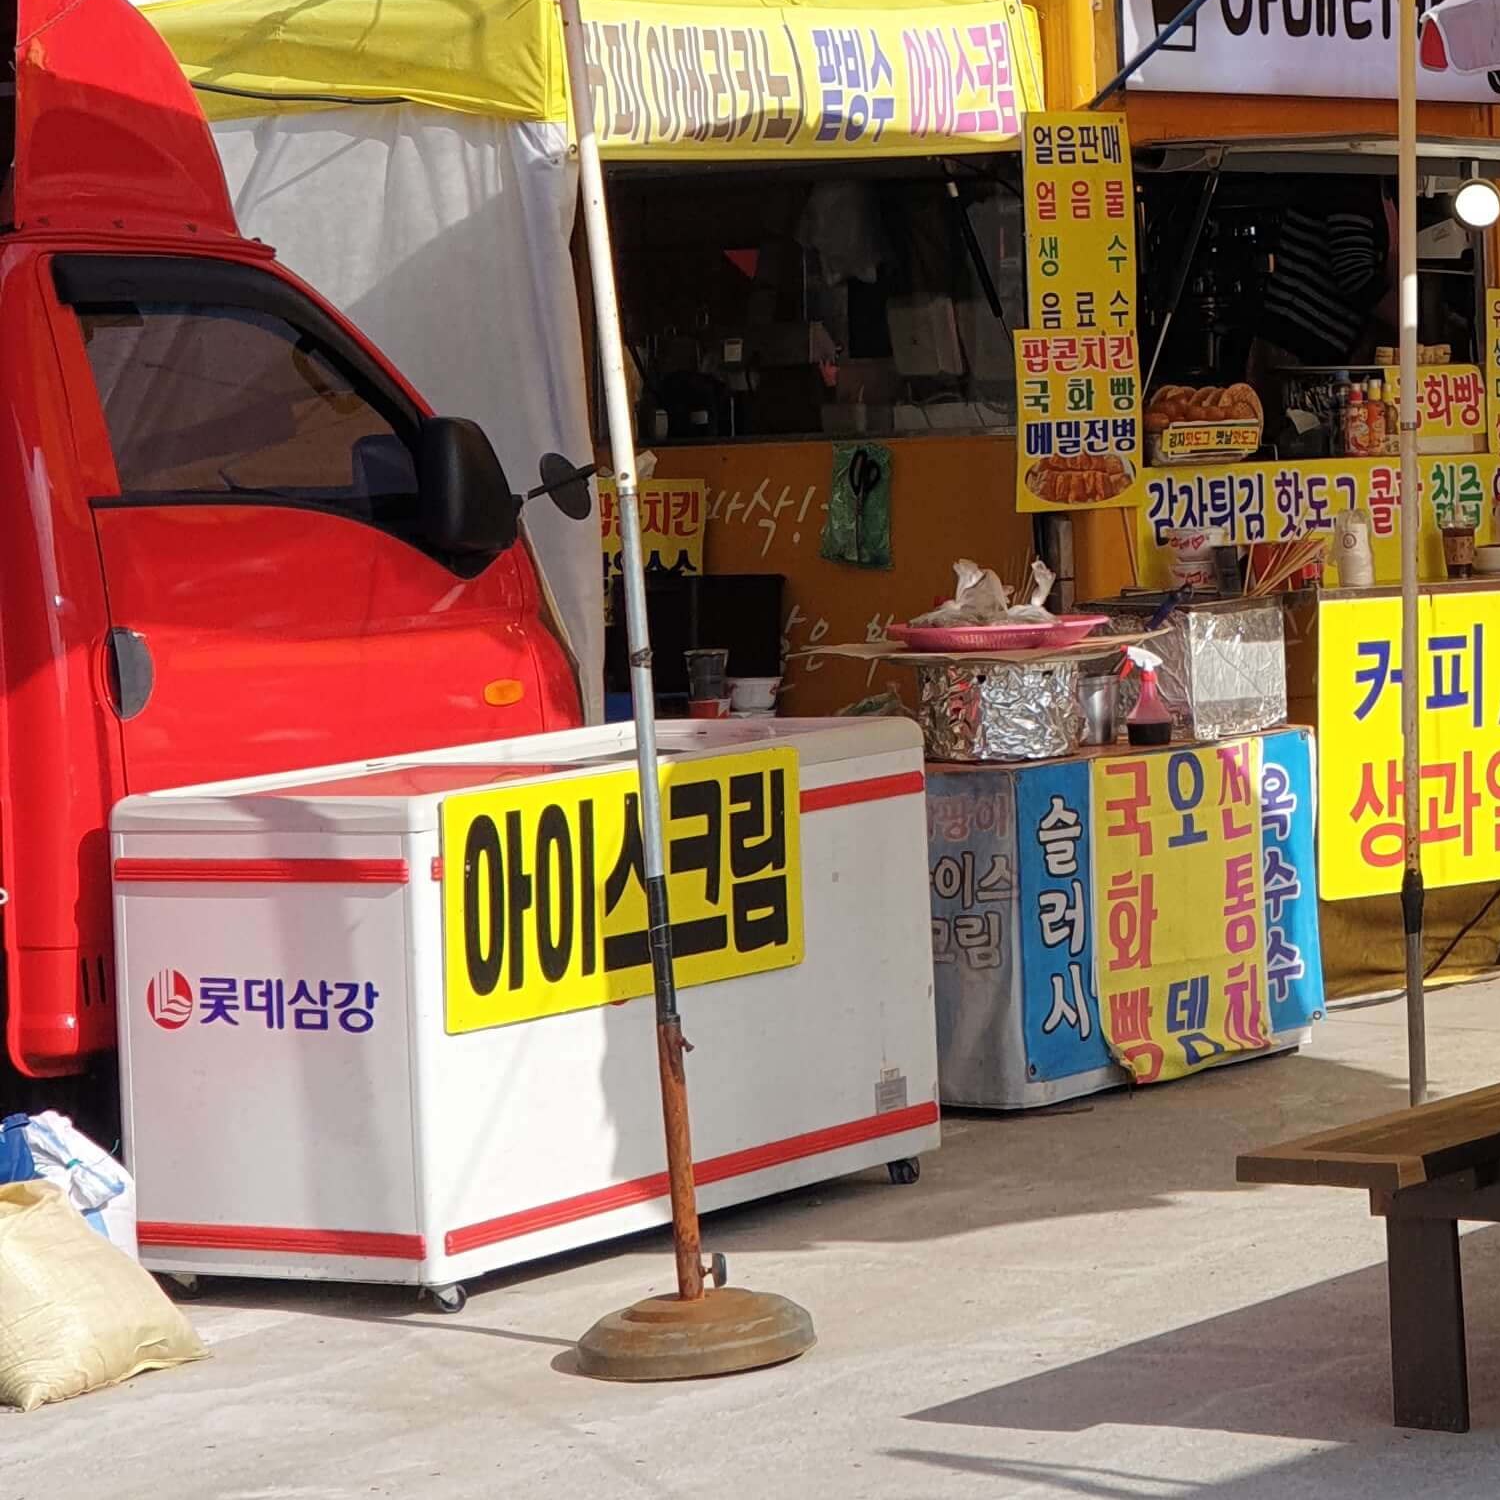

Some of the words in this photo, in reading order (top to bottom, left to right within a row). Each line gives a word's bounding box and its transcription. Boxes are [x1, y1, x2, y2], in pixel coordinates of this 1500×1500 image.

[812, 27, 895, 143] 팥빙수
[901, 21, 1018, 138] 아이스크림
[1033, 124, 1122, 165] 얼음판매
[1036, 180, 1126, 221] 얼음물
[1041, 290, 1130, 329] 음료수
[1021, 334, 1135, 374] 팝콘치킨
[1023, 376, 1137, 415] 국화빵
[1025, 417, 1137, 458] 메밀전병
[1148, 472, 1265, 549] 감자튀김
[1274, 470, 1358, 538] 핫도그
[463, 768, 789, 996] 아이스크림
[1216, 736, 1274, 1050] 전통차
[1262, 762, 1304, 1003] 옥수수
[1039, 794, 1091, 1042] 슬러시
[1105, 761, 1165, 1084] 국화빵
[199, 976, 380, 1034] 롯데삼강
